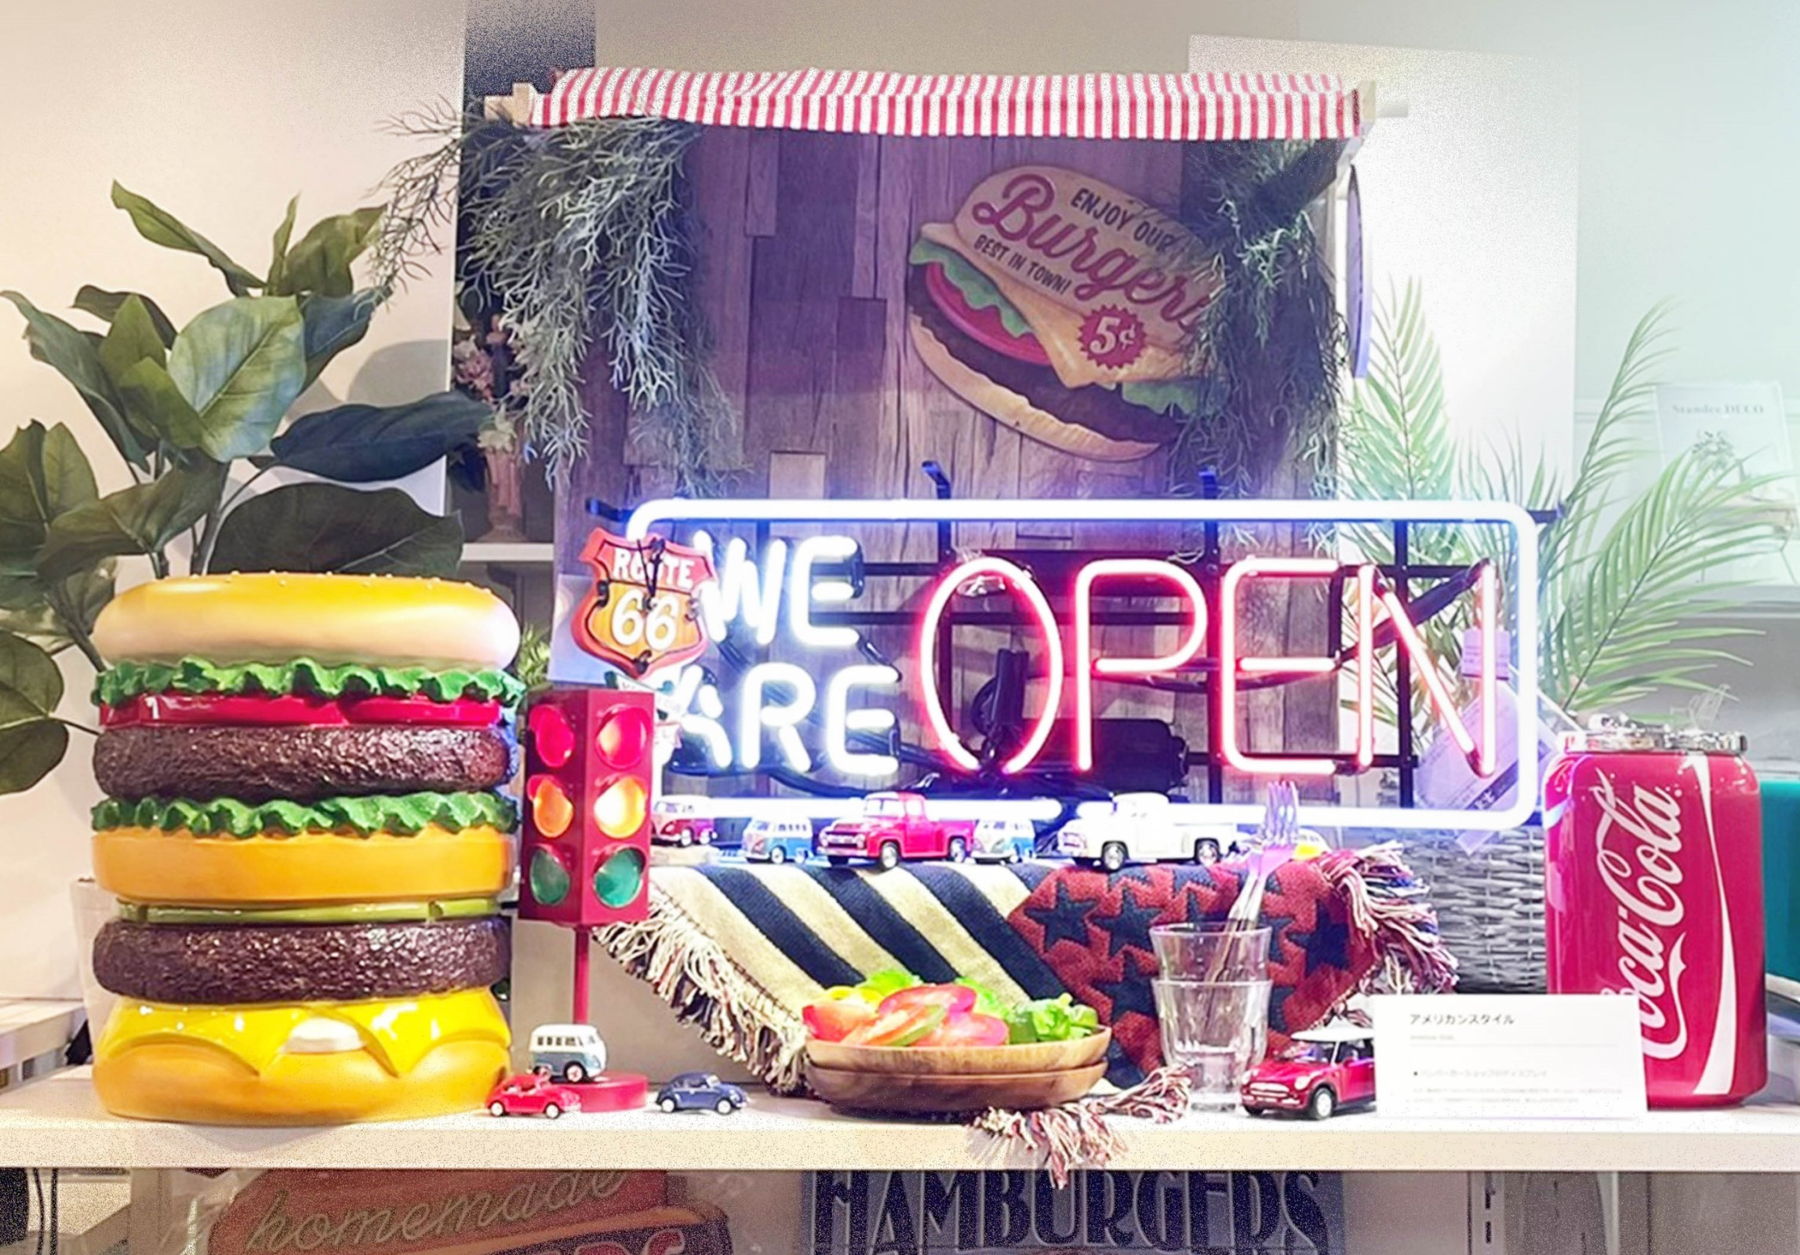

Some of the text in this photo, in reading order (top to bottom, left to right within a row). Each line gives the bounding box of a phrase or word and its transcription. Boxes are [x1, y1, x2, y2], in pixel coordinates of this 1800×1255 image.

[1070, 187, 1176, 254] ENJOY OUR
[973, 233, 1073, 296] BEST IN TOWN!
[612, 547, 696, 590] ROUTE
[693, 530, 860, 646] WE
[611, 588, 680, 653] 66
[920, 557, 1497, 777] OPEN
[676, 661, 900, 776] ARE
[1410, 1013, 1515, 1025] アメリカンスタイル
[246, 1171, 627, 1251] homemade
[811, 1170, 1329, 1255] HAMBURGERS
